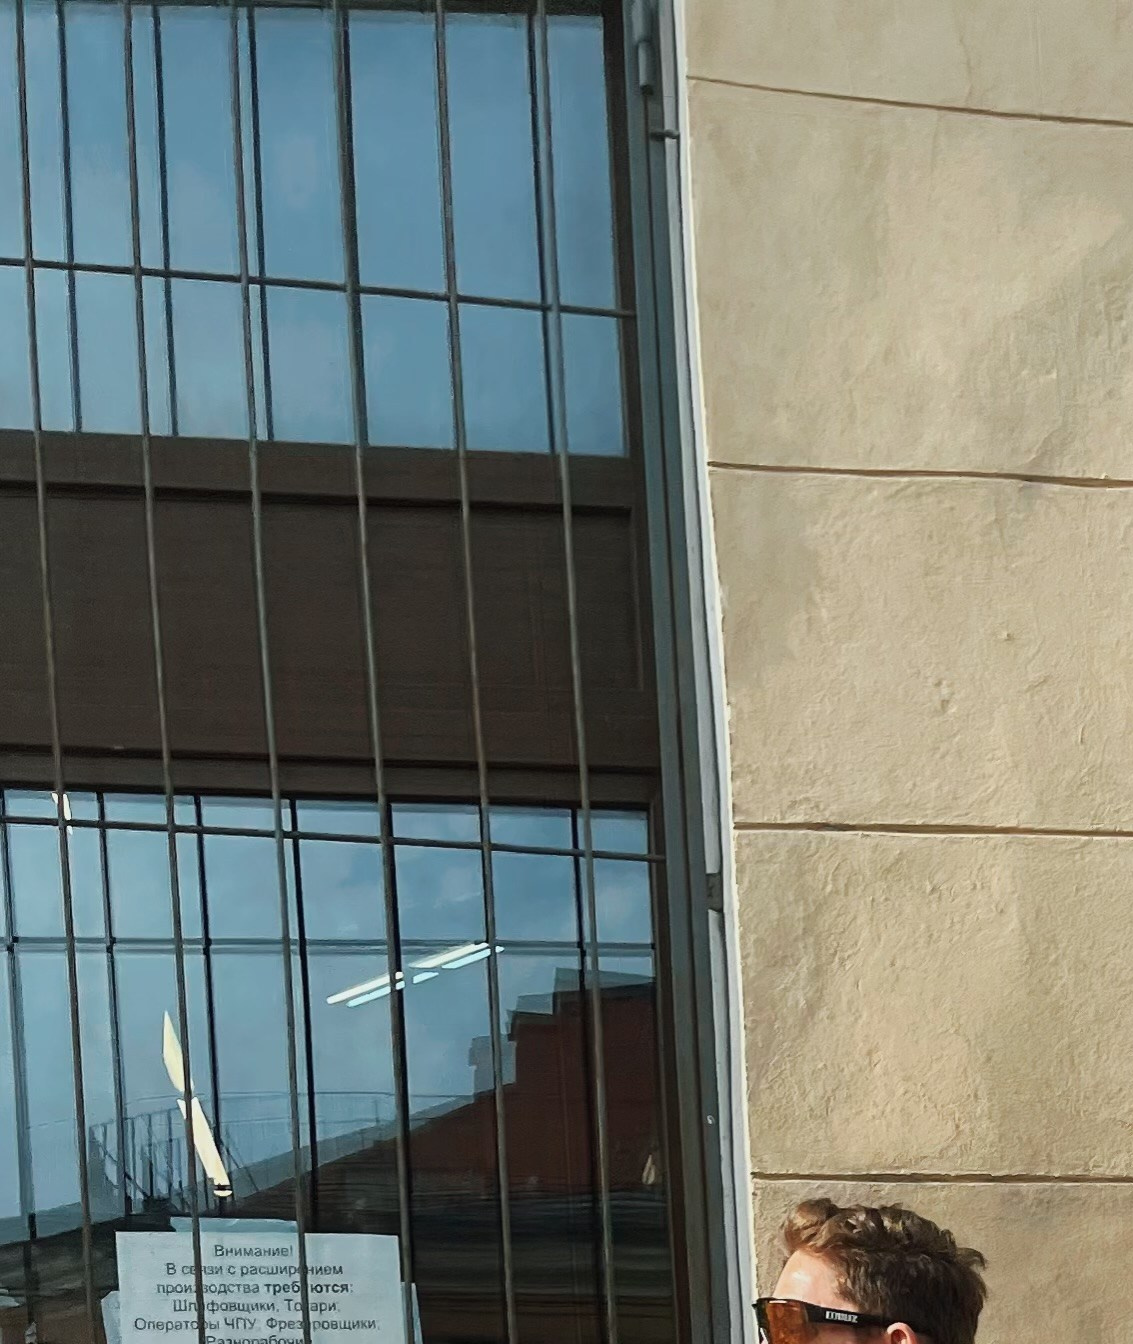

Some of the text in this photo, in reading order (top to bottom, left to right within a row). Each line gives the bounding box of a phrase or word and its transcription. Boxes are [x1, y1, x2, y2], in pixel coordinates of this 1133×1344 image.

[214, 1244, 293, 1257] Внимание!
[166, 1262, 177, 1275] В
[227, 1265, 237, 1275] с
[240, 1265, 344, 1278] расширнием
[157, 1281, 354, 1295] проиводства требются:
